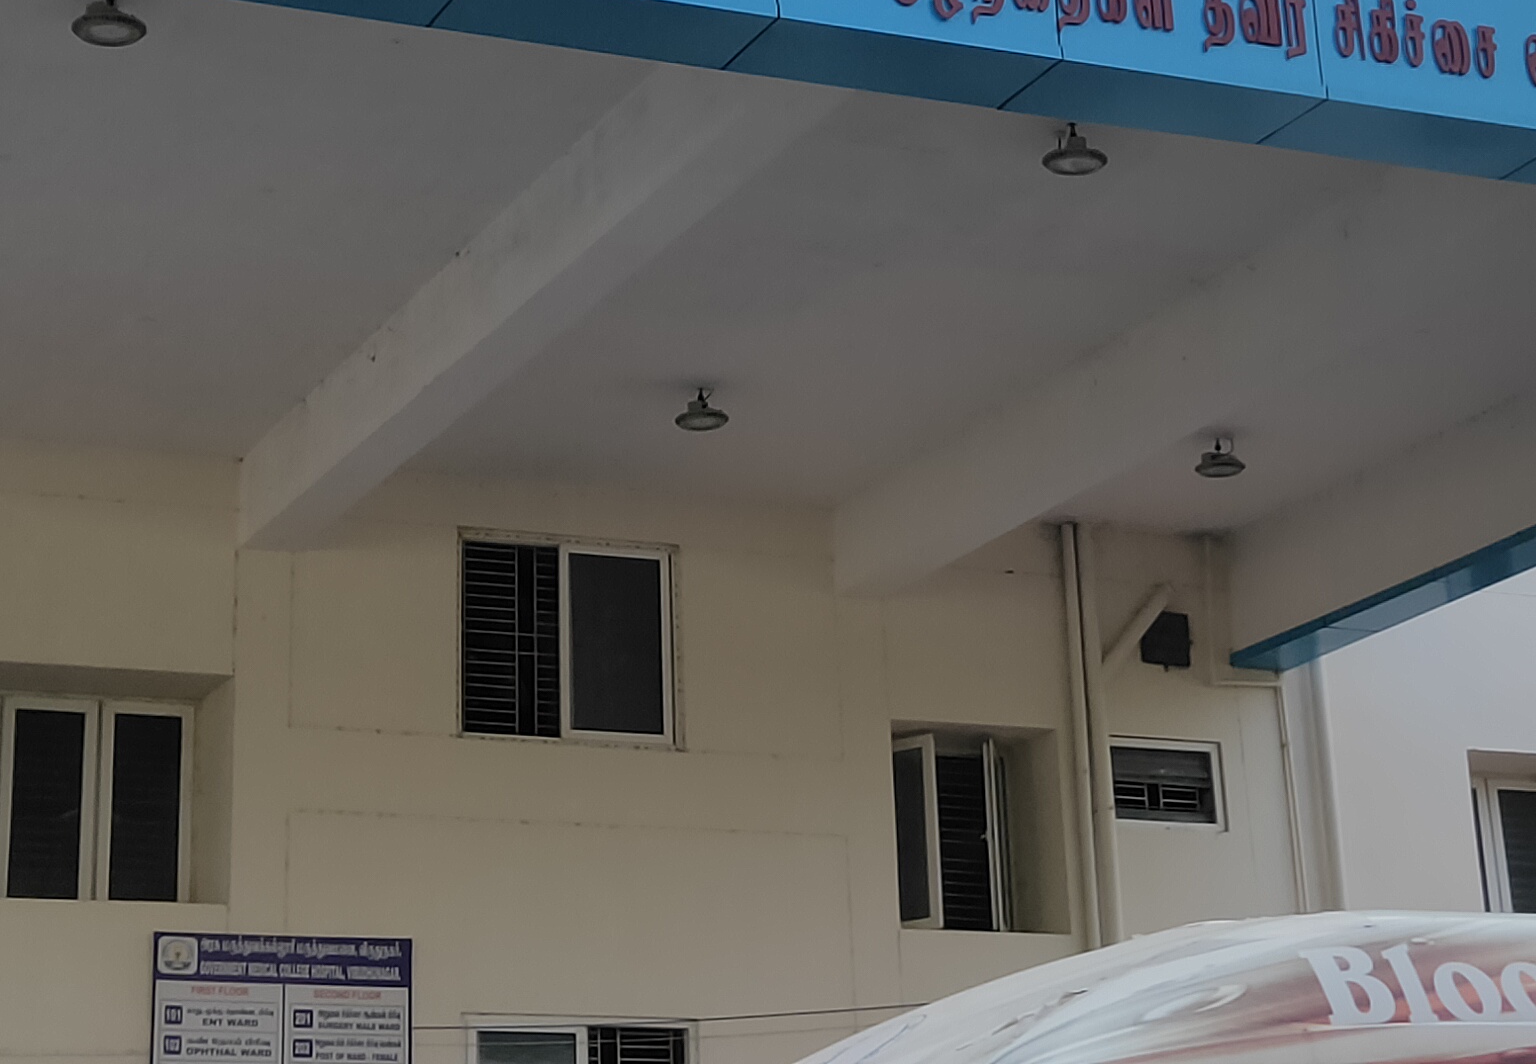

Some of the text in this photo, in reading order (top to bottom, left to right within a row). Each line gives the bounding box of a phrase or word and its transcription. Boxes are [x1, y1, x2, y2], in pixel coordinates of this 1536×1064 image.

[190, 986, 249, 996] FIRST FLOOR
[202, 1018, 259, 1027] ENT WARD
[241, 1048, 272, 1057] WARD
